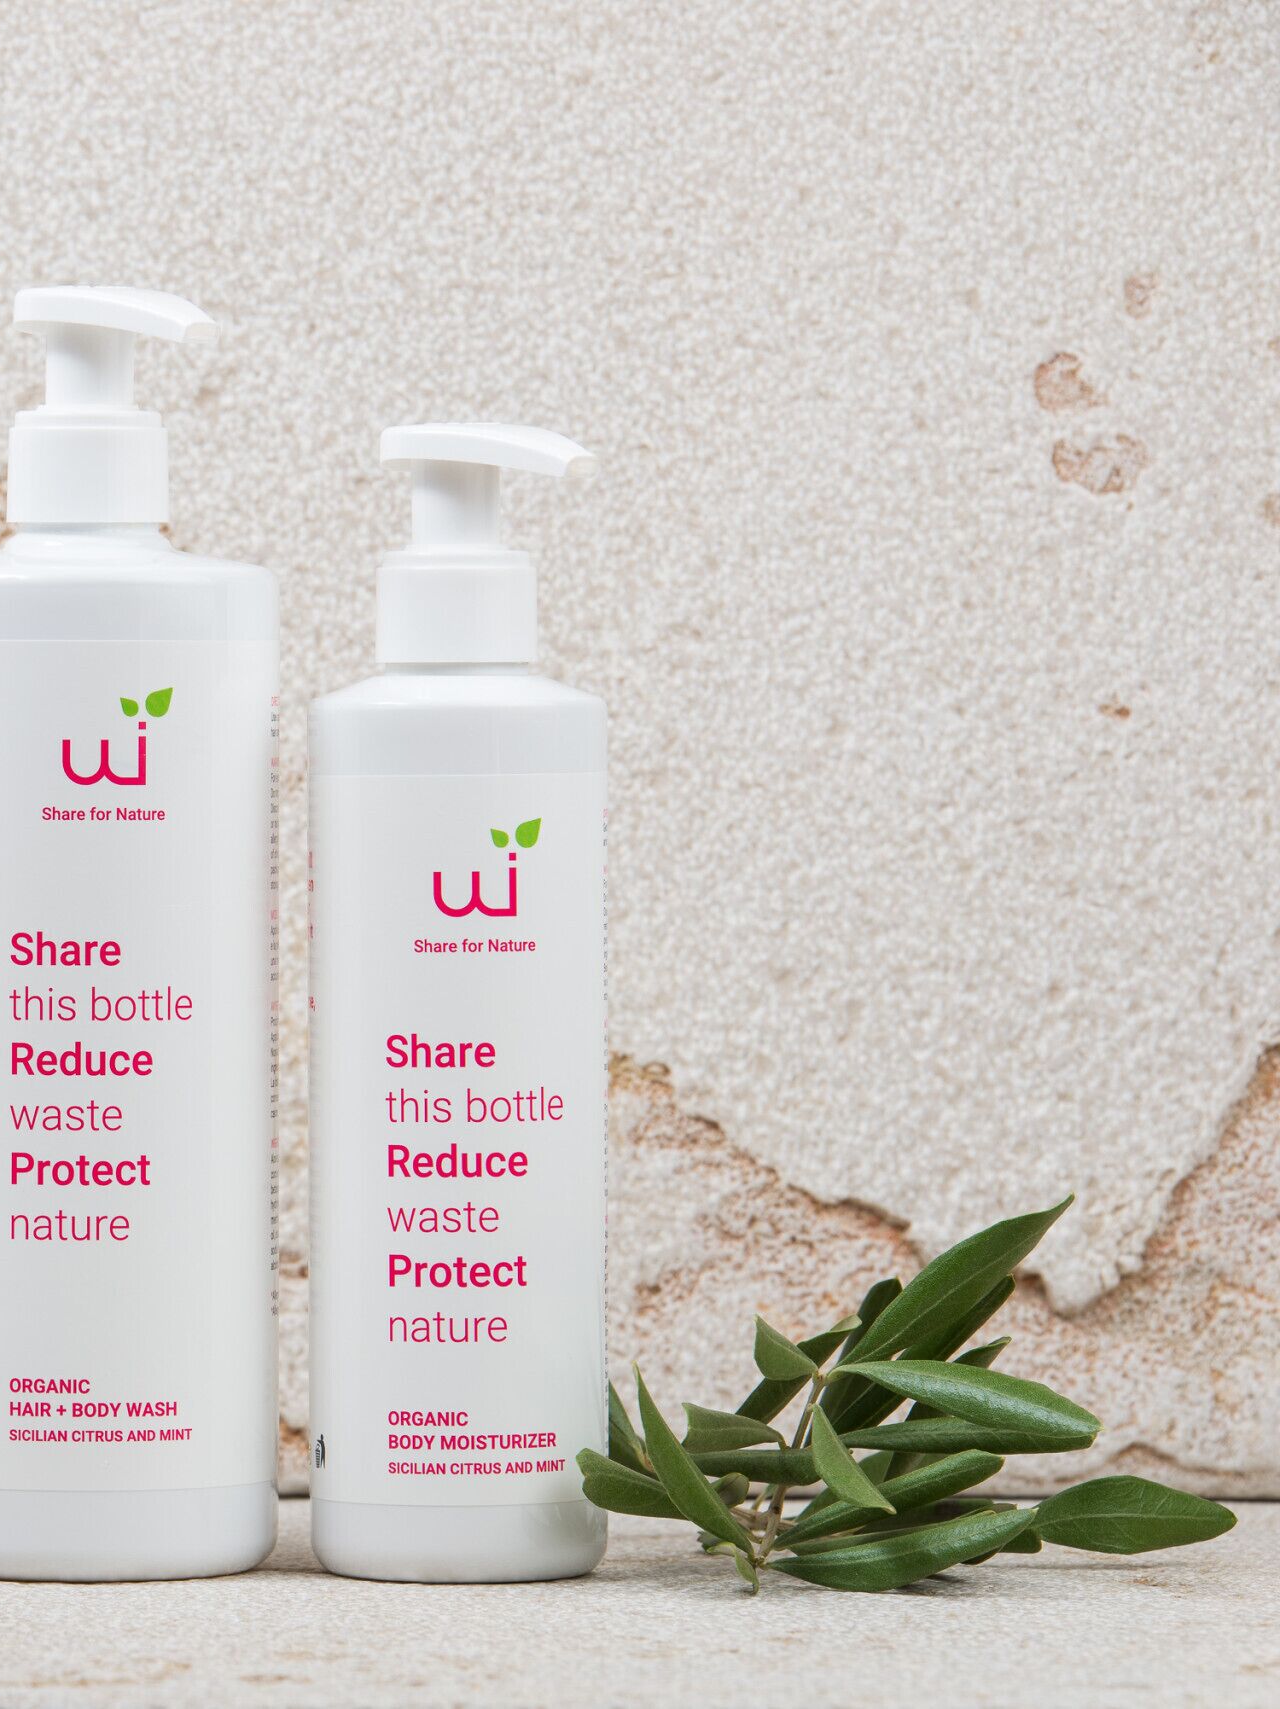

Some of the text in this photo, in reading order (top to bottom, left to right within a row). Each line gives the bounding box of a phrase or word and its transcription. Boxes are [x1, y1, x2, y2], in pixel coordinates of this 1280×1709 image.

[42, 806, 166, 821] Share for Nature
[10, 930, 121, 967] Share
[413, 938, 536, 954] Share for Nature
[9, 984, 193, 1022] this bottle
[11, 1041, 153, 1077] Reduce
[385, 1032, 496, 1069] Share
[10, 1099, 123, 1132] waste
[385, 1087, 564, 1124] this bottle
[11, 1151, 151, 1187] Protect
[387, 1142, 528, 1179] Reduce
[10, 1208, 130, 1242] nature
[387, 1201, 500, 1233] waste
[388, 1253, 528, 1289] Protect
[389, 1312, 508, 1343] nature
[9, 1377, 90, 1395] ORGANIC
[8, 1400, 177, 1419] HAIR + BODY WASH
[387, 1410, 469, 1428] ORGANIC
[8, 1428, 192, 1443] SICILIAN CITRUS AND MINT
[388, 1431, 557, 1451] BODY MOISTURIZER
[388, 1458, 565, 1476] SICILIAN CITRUS AND MINT
